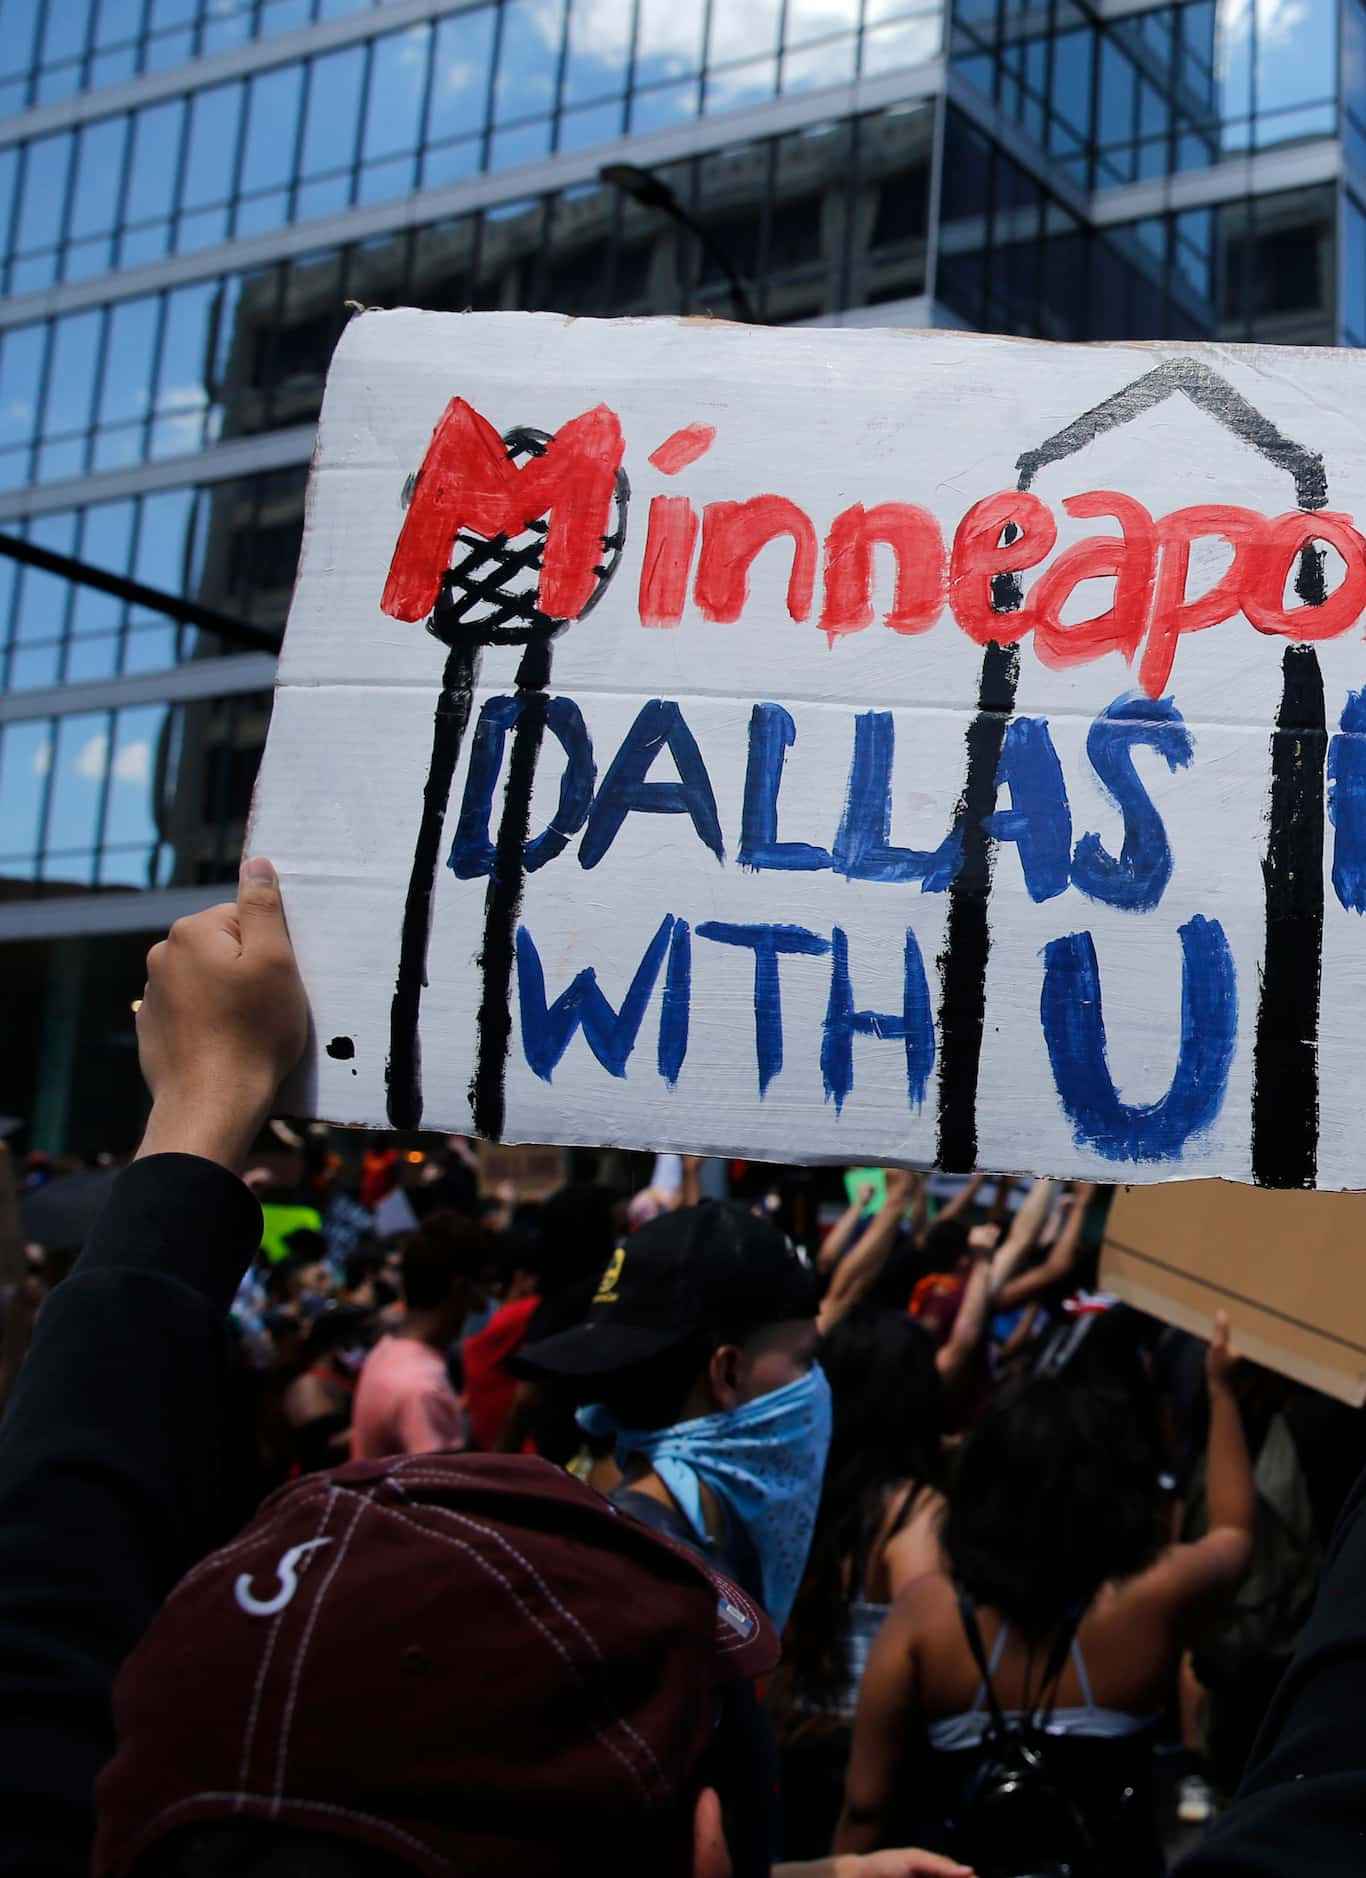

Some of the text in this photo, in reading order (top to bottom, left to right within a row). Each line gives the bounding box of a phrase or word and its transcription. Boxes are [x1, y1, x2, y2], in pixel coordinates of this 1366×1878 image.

[447, 689, 1196, 912] DALLAS
[516, 912, 1239, 1163] WITH U
